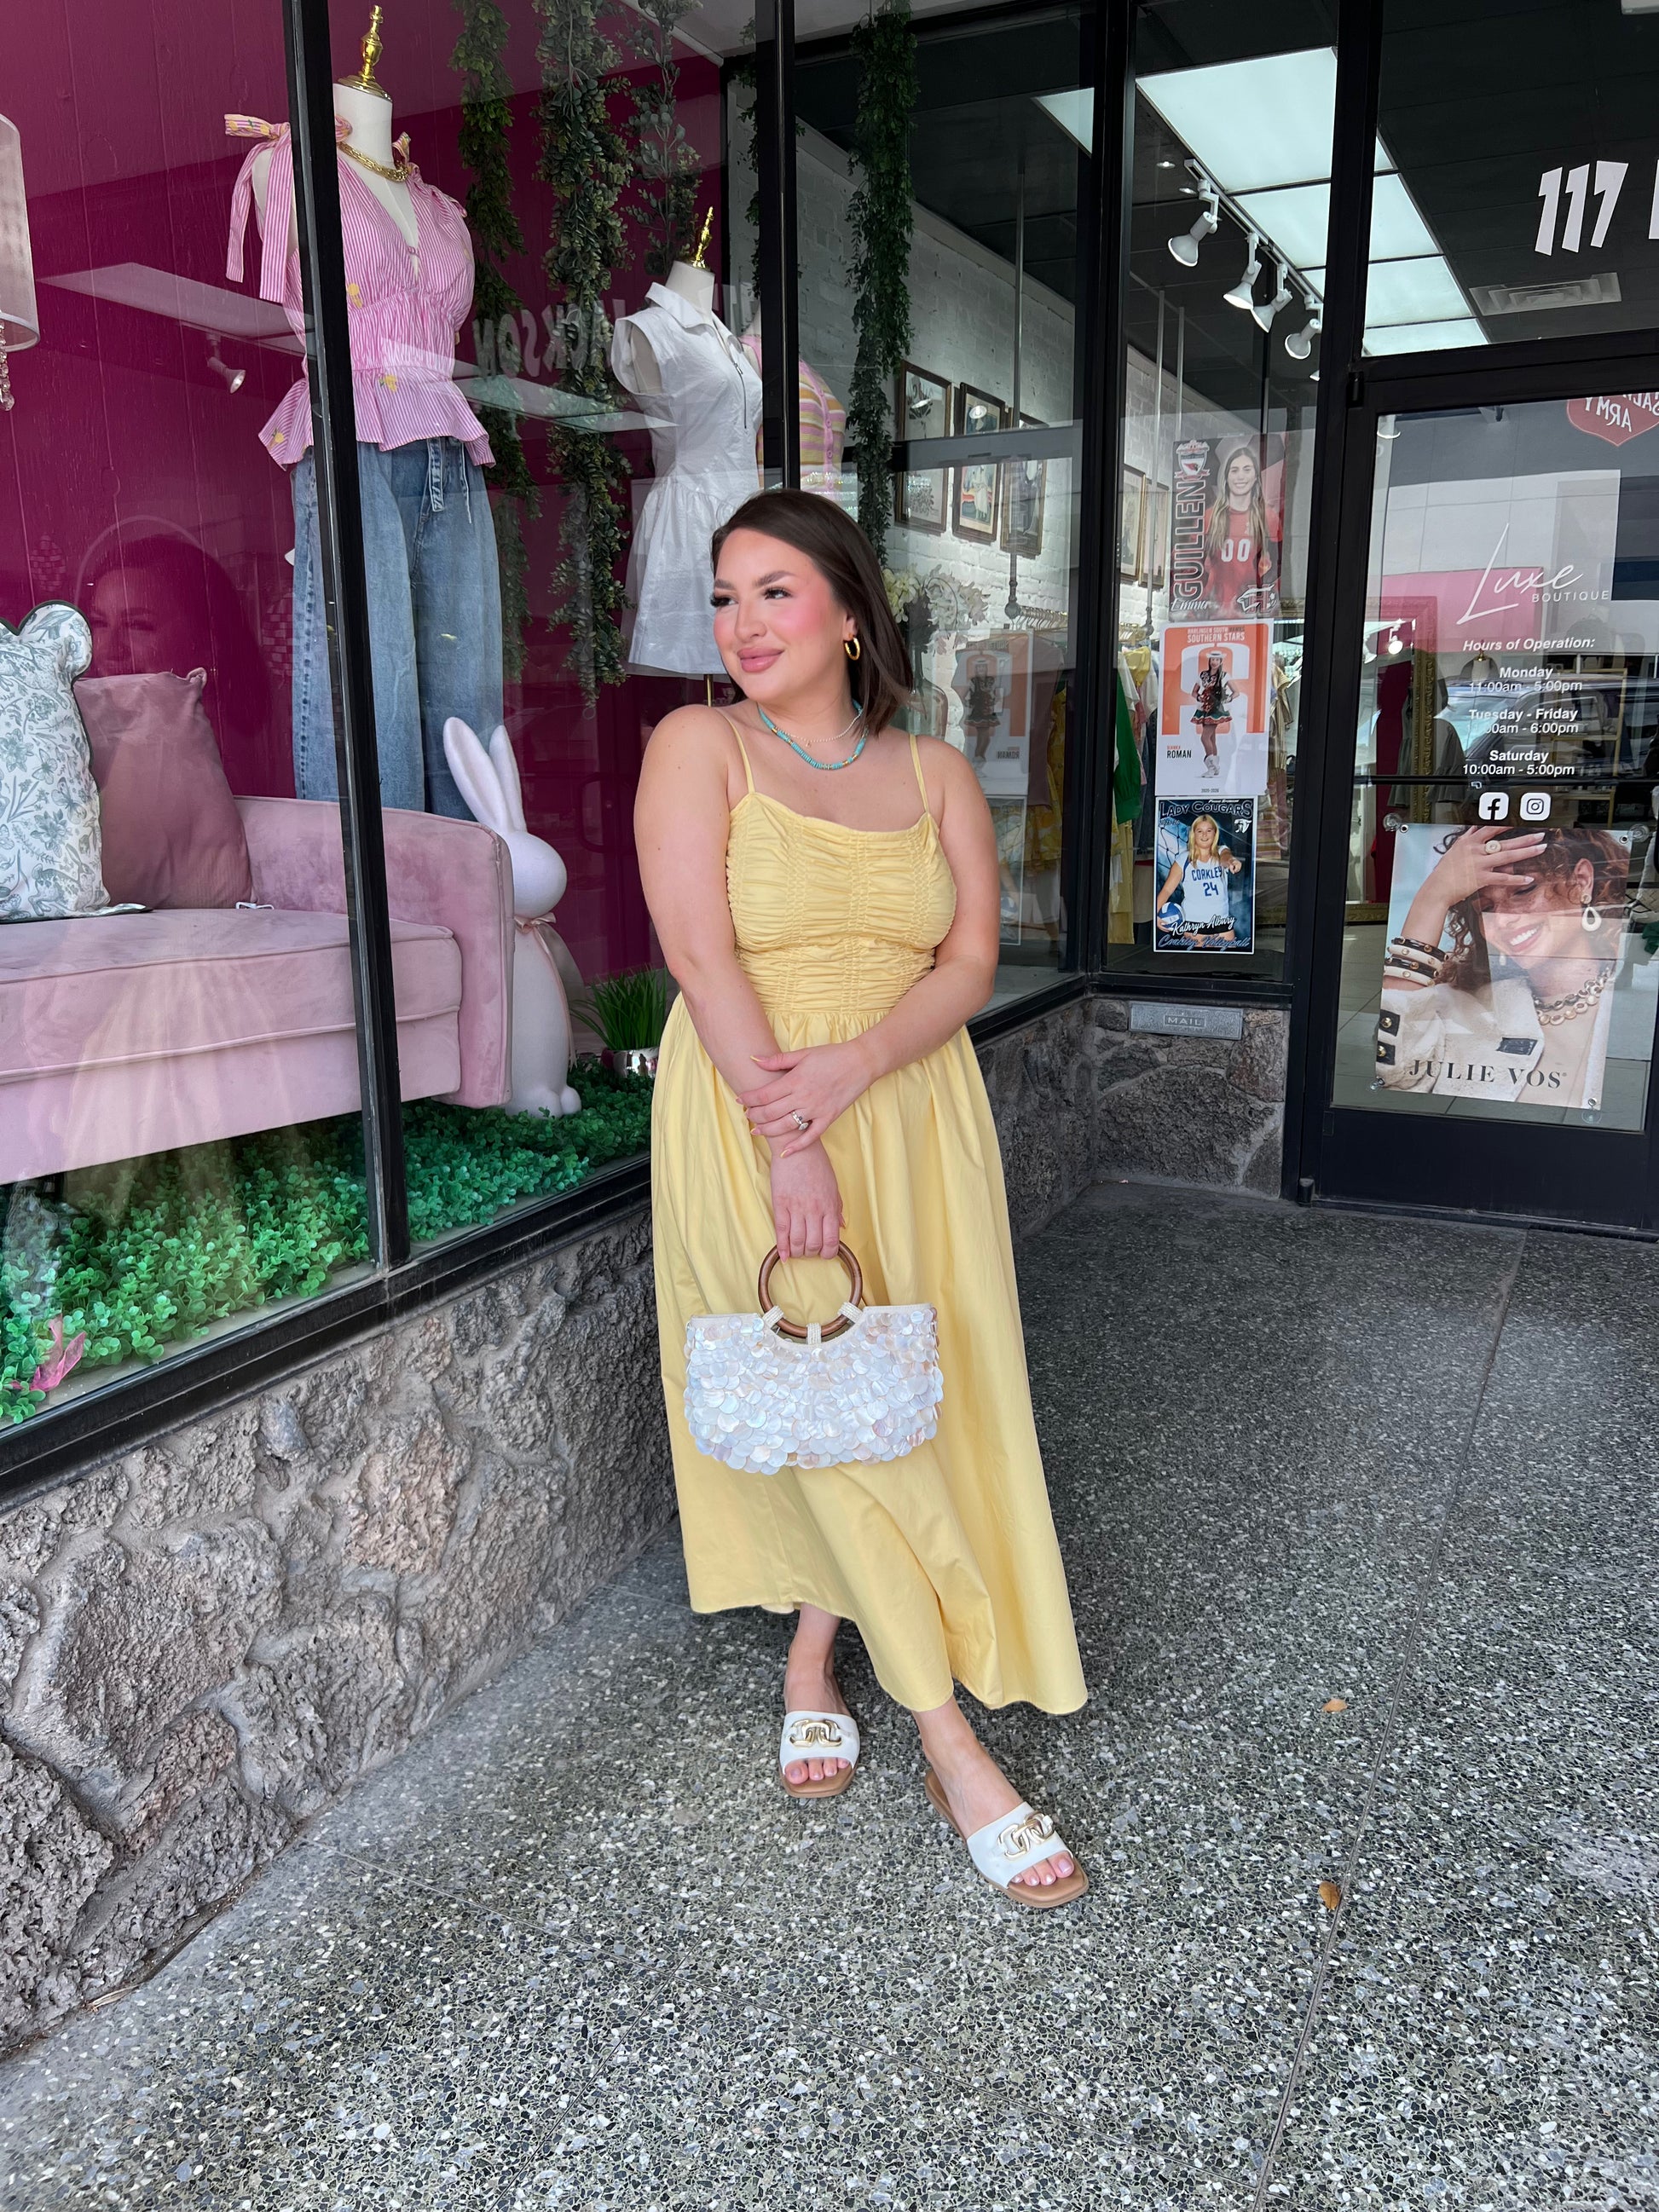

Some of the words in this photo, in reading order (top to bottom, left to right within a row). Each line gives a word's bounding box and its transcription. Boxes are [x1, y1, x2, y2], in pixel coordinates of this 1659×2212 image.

[1535, 160, 1629, 256] 117
[1173, 479, 1206, 601] GUILLEN
[1221, 539, 1251, 562] 00
[1456, 523, 1583, 625] Luxe
[1531, 590, 1610, 604] BOUTIQUE
[1188, 633, 1222, 643] SOUTHERN
[1223, 632, 1245, 641] STARS
[1463, 639, 1502, 651] Hours
[1506, 638, 1521, 650] of
[1523, 638, 1596, 652] Operation:
[1499, 666, 1553, 679] Monday
[1469, 682, 1523, 692] 11:00am
[1535, 681, 1582, 693] 5:00pm
[1469, 709, 1523, 722] Tuesday
[1535, 708, 1578, 721] Friday
[1530, 723, 1579, 735] 6:00pm
[1166, 750, 1192, 759] ROMAN
[1489, 750, 1549, 764] Saturday
[1463, 764, 1516, 775] 10:00am
[1526, 764, 1575, 777] 5:00pm
[1159, 801, 1189, 817] LADY
[1192, 800, 1253, 819] COUGARS
[1203, 881, 1219, 897] 24
[1171, 921, 1205, 936] Kathryn
[1167, 1016, 1201, 1026] MAIL
[1409, 1060, 1494, 1083] JULIE
